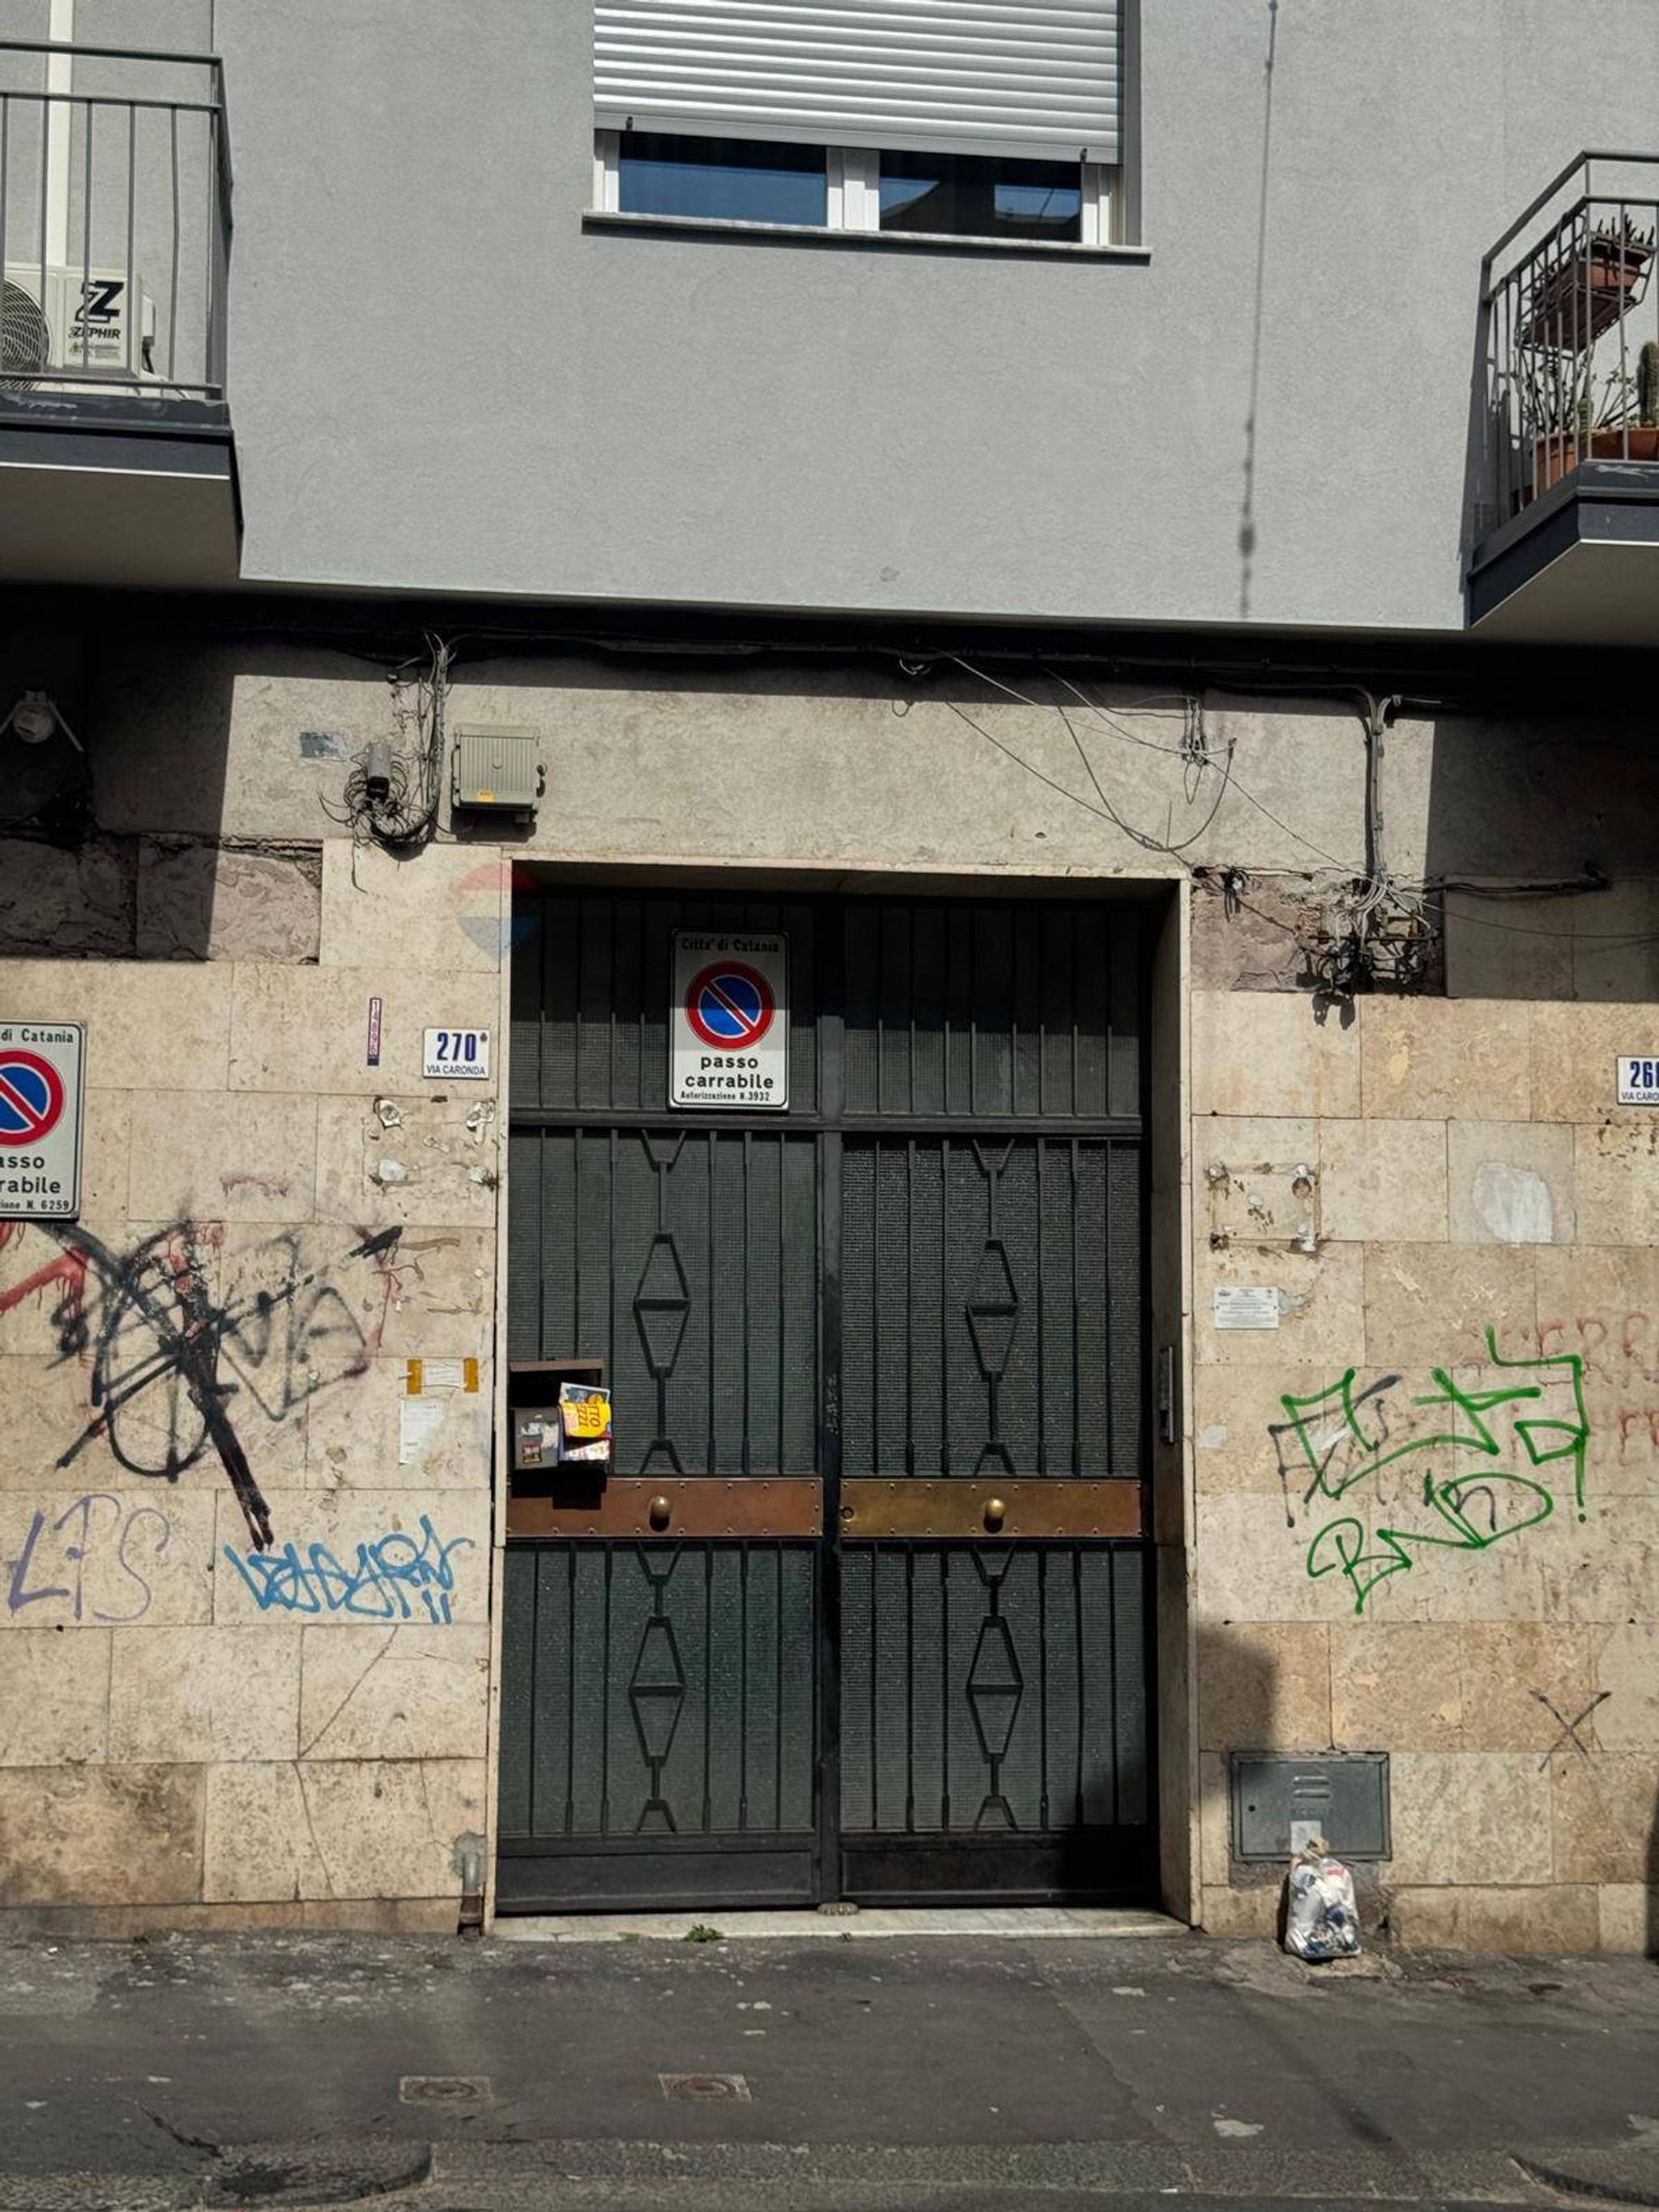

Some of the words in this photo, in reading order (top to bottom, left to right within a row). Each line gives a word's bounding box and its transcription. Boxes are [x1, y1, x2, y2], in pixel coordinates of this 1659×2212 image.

[717, 938, 729, 951] di
[732, 938, 779, 953] Catania
[1, 1029, 12, 1042] di
[21, 1029, 74, 1043] Catania
[437, 1032, 476, 1062] 270
[427, 1064, 441, 1074] VIA
[442, 1064, 486, 1076] CARONDA
[701, 1056, 758, 1070] passo
[684, 1074, 774, 1089] carrabile
[680, 1091, 736, 1100] Autorizzazione
[1621, 1092, 1635, 1101] VIA
[41, 1200, 70, 1211] 6259
